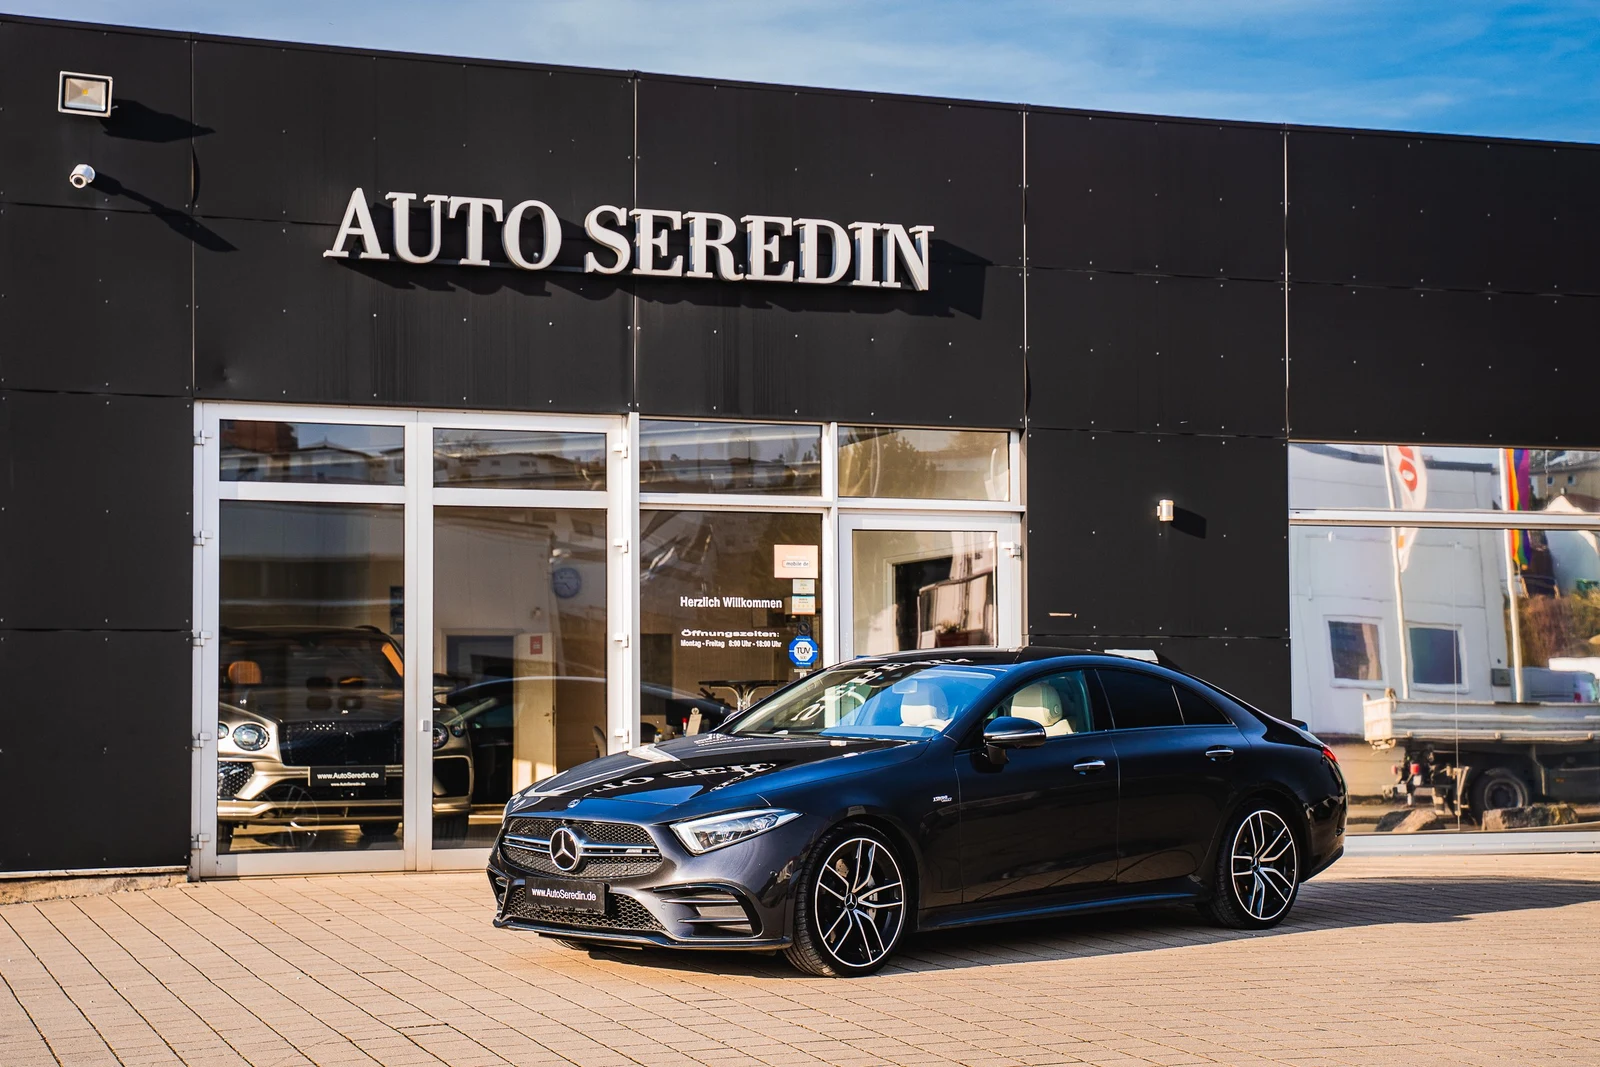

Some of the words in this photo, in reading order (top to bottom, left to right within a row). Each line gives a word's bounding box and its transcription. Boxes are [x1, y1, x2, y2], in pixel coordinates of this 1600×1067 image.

[323, 187, 562, 271] AUTO
[584, 204, 935, 292] SEREDIN
[680, 596, 720, 608] Herzlich
[722, 597, 782, 608] Willkommen
[681, 628, 780, 638] Öffnungszeiten:
[680, 639, 701, 648] Montag
[705, 639, 725, 649] Freitag
[741, 640, 752, 648] Uhr
[771, 640, 782, 648] Uhr
[531, 887, 597, 901] www.AutoSeredin.de
